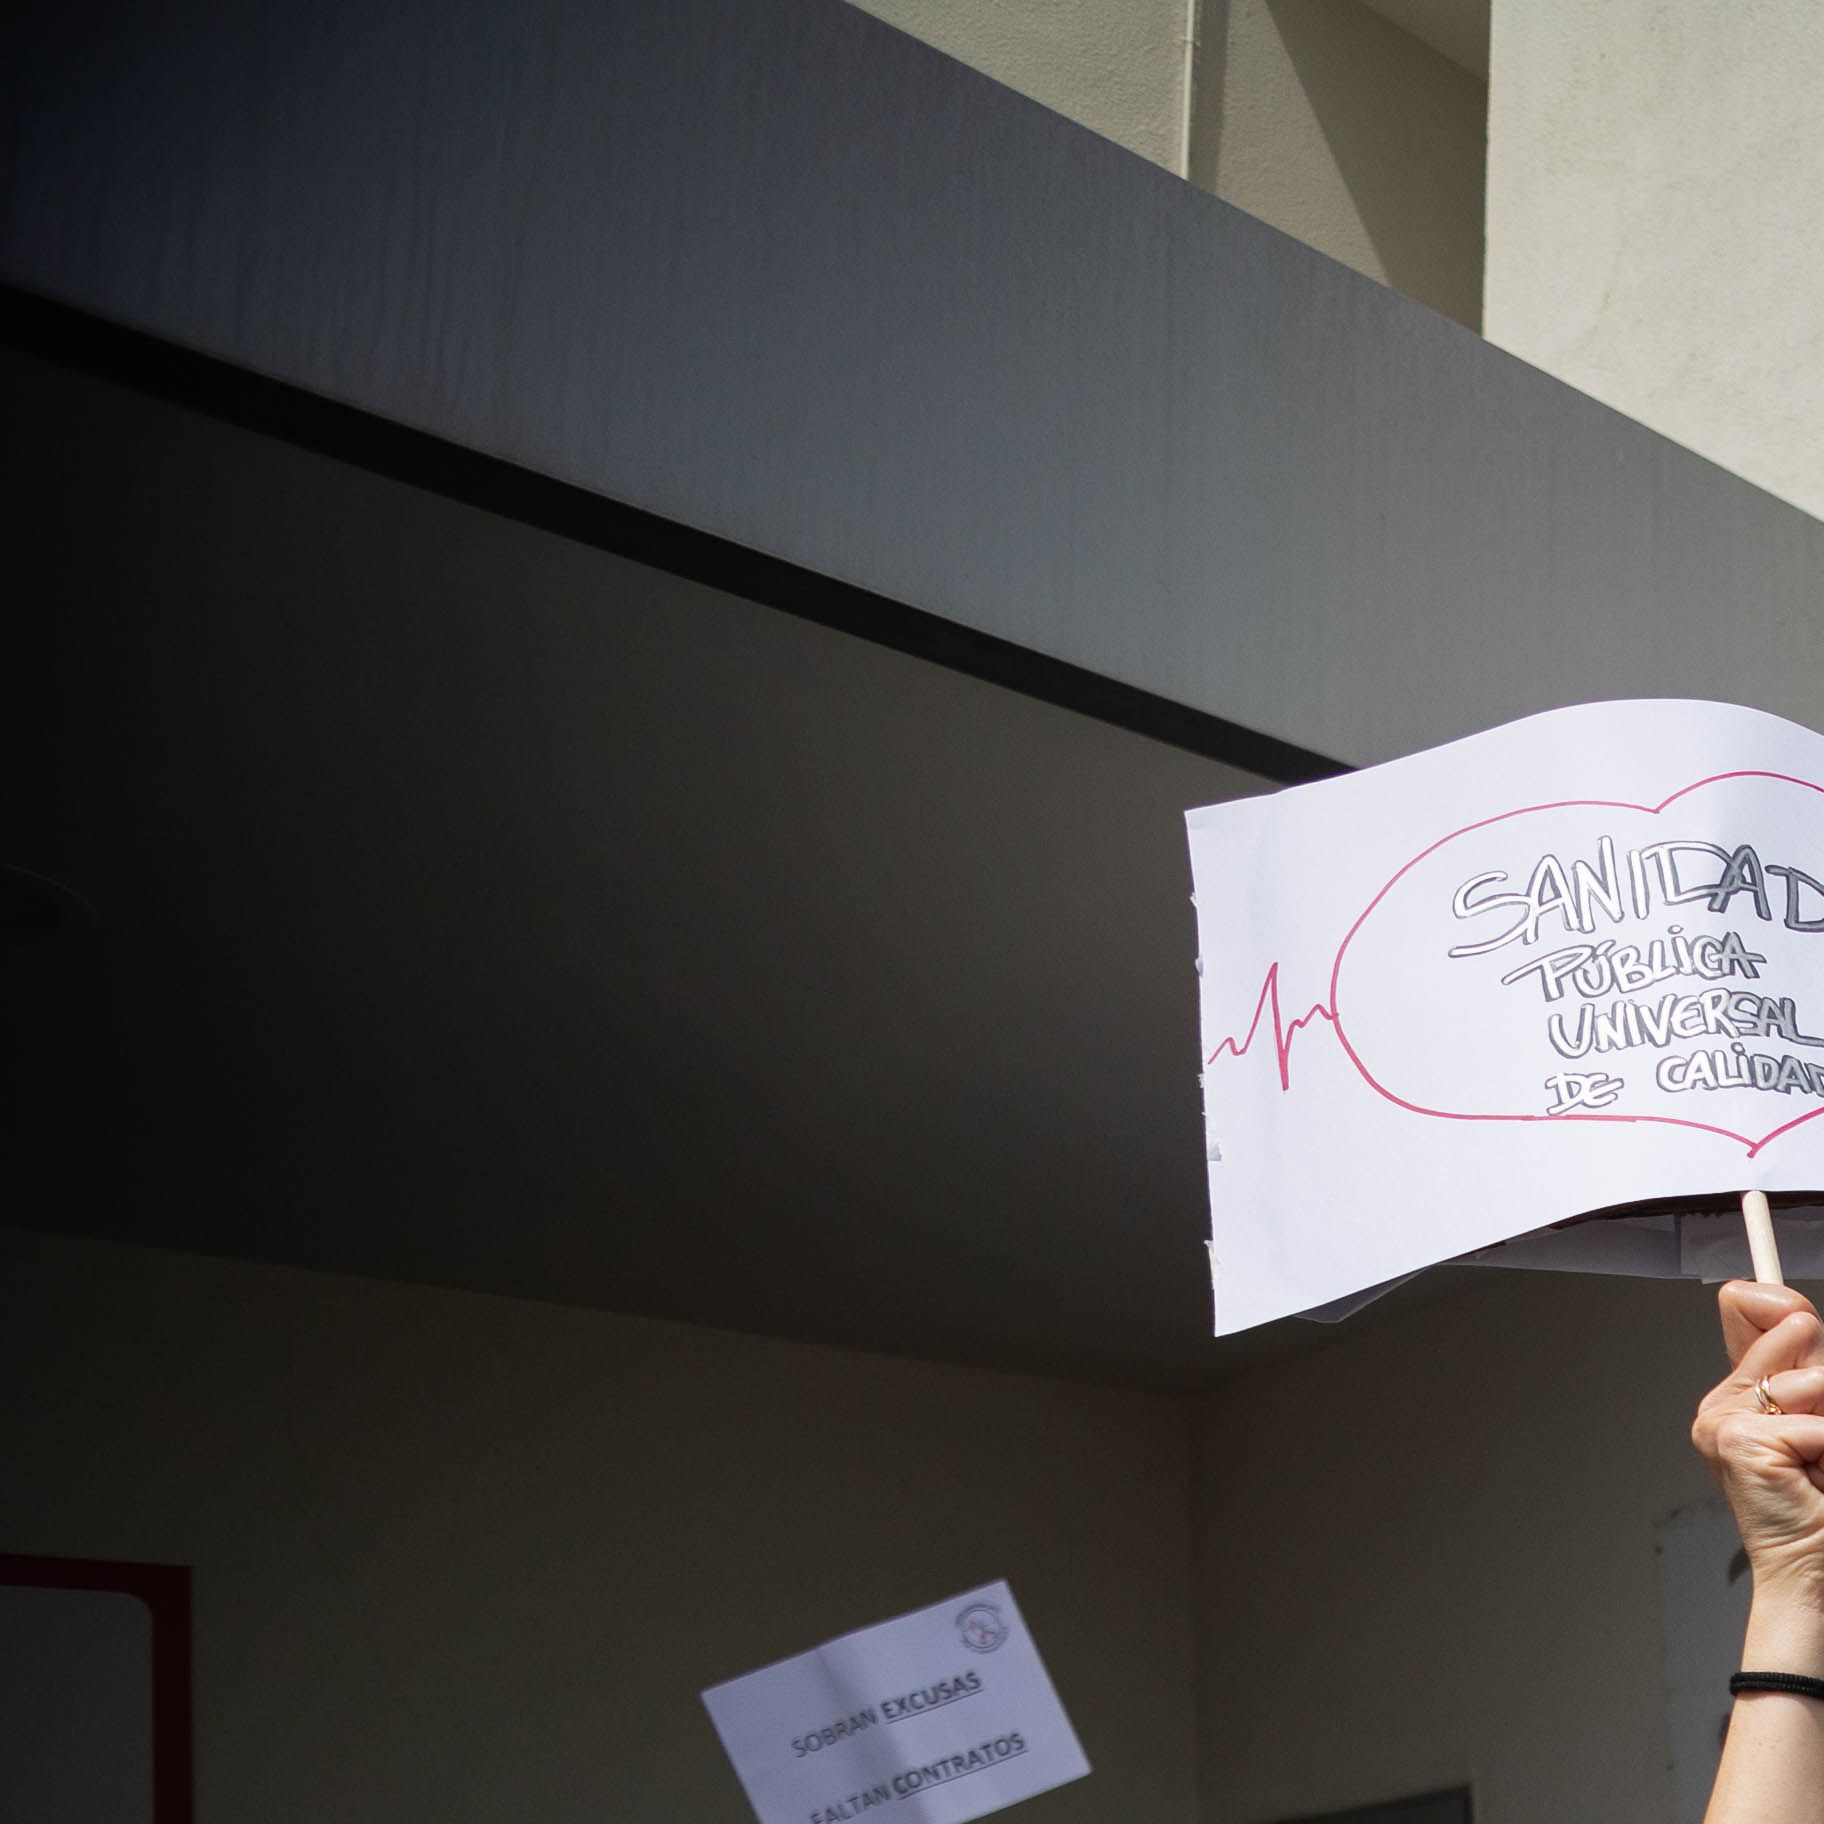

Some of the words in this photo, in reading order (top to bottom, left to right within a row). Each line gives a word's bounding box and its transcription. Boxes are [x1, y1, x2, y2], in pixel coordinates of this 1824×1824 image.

[1547, 1072, 1623, 1115] DE
[791, 1707, 879, 1758] SOBRAN
[880, 1671, 983, 1720] EXCUSAS
[892, 1732, 1026, 1796] CONTRATOS
